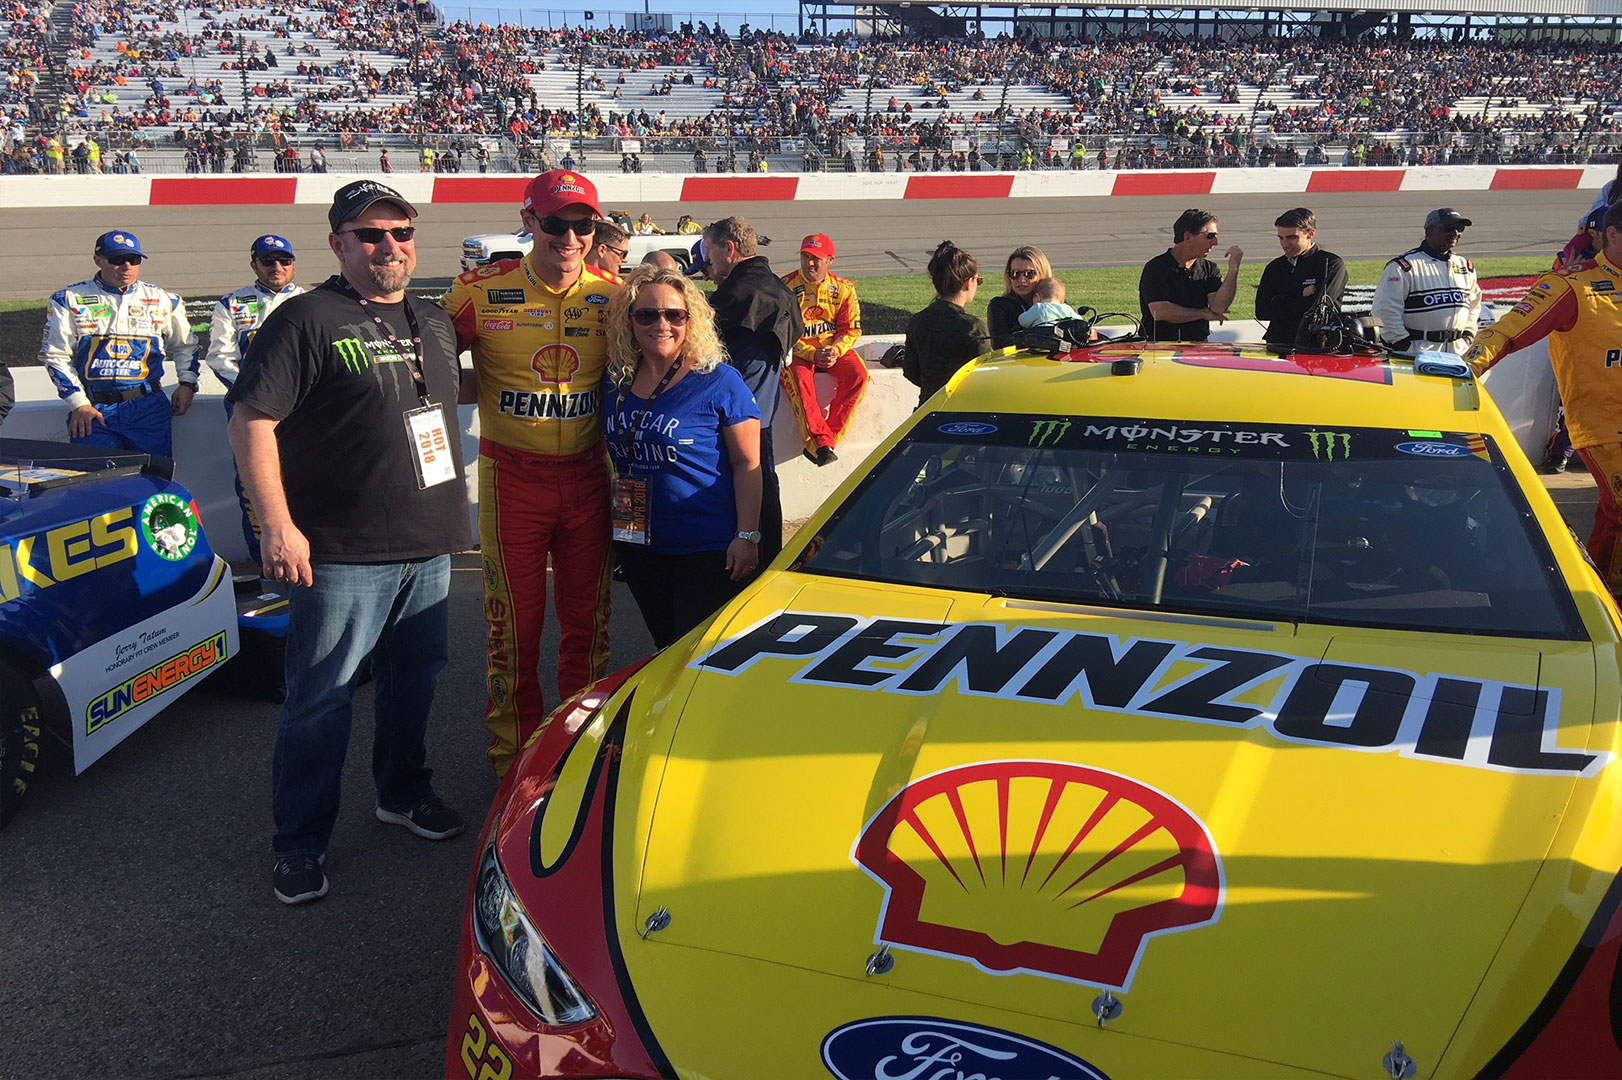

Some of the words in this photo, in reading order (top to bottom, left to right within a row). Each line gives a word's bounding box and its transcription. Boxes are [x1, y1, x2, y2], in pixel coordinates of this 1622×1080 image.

[481, 307, 519, 315] GOODYEAR
[109, 343, 129, 354] NAPA
[99, 368, 131, 376] CENTER
[418, 432, 436, 464] 2018
[431, 427, 446, 451] HOT
[1126, 443, 1241, 454] ENERGY
[1411, 442, 1460, 456] Ford
[141, 494, 193, 526] AMERICAN
[138, 627, 167, 644] Tatum
[489, 599, 510, 672] Shell
[105, 654, 136, 673] HONORARY
[135, 648, 144, 659] PIT
[144, 641, 159, 655] CREW
[158, 631, 180, 646] MEMBER
[692, 611, 1608, 775] PENNZOIL
[461, 1013, 513, 1080] 22
